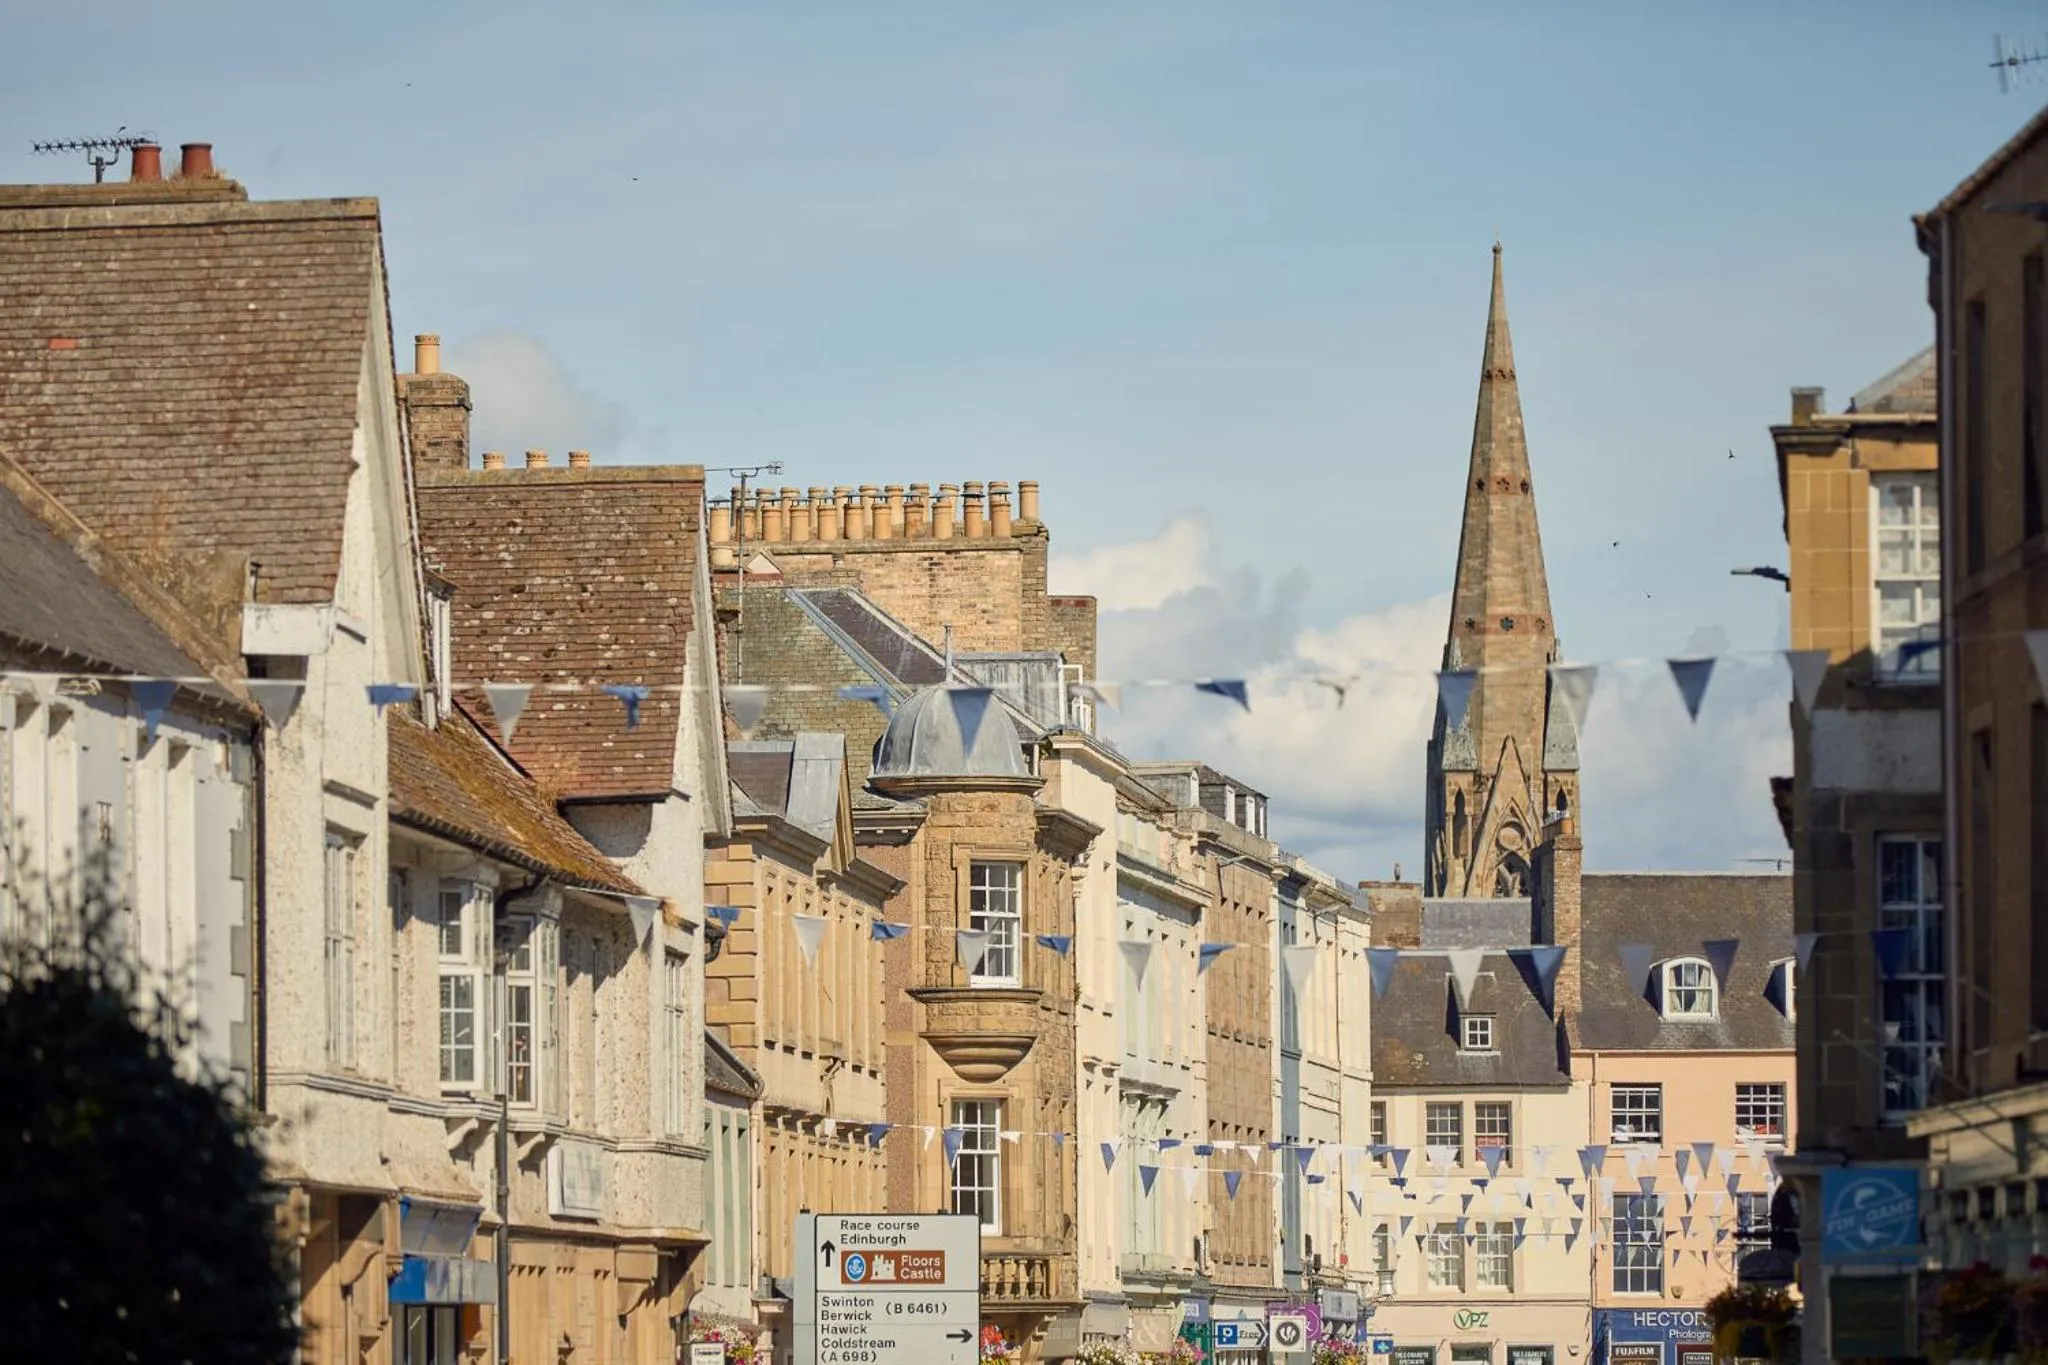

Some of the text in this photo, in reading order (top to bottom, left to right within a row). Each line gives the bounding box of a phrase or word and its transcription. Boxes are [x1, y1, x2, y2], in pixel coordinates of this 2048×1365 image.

[840, 1220, 920, 1230] Race course
[840, 1234, 906, 1246] Edinburgh
[901, 1255, 941, 1266] Floors
[900, 1268, 941, 1279] Castle
[822, 1296, 874, 1307] Swinton
[821, 1310, 872, 1320] Berwick
[1456, 1309, 1489, 1328] VPZ
[821, 1324, 867, 1334] Hawick
[821, 1338, 895, 1348] Coldstream
[1615, 1347, 1654, 1355] FUJIFILM
